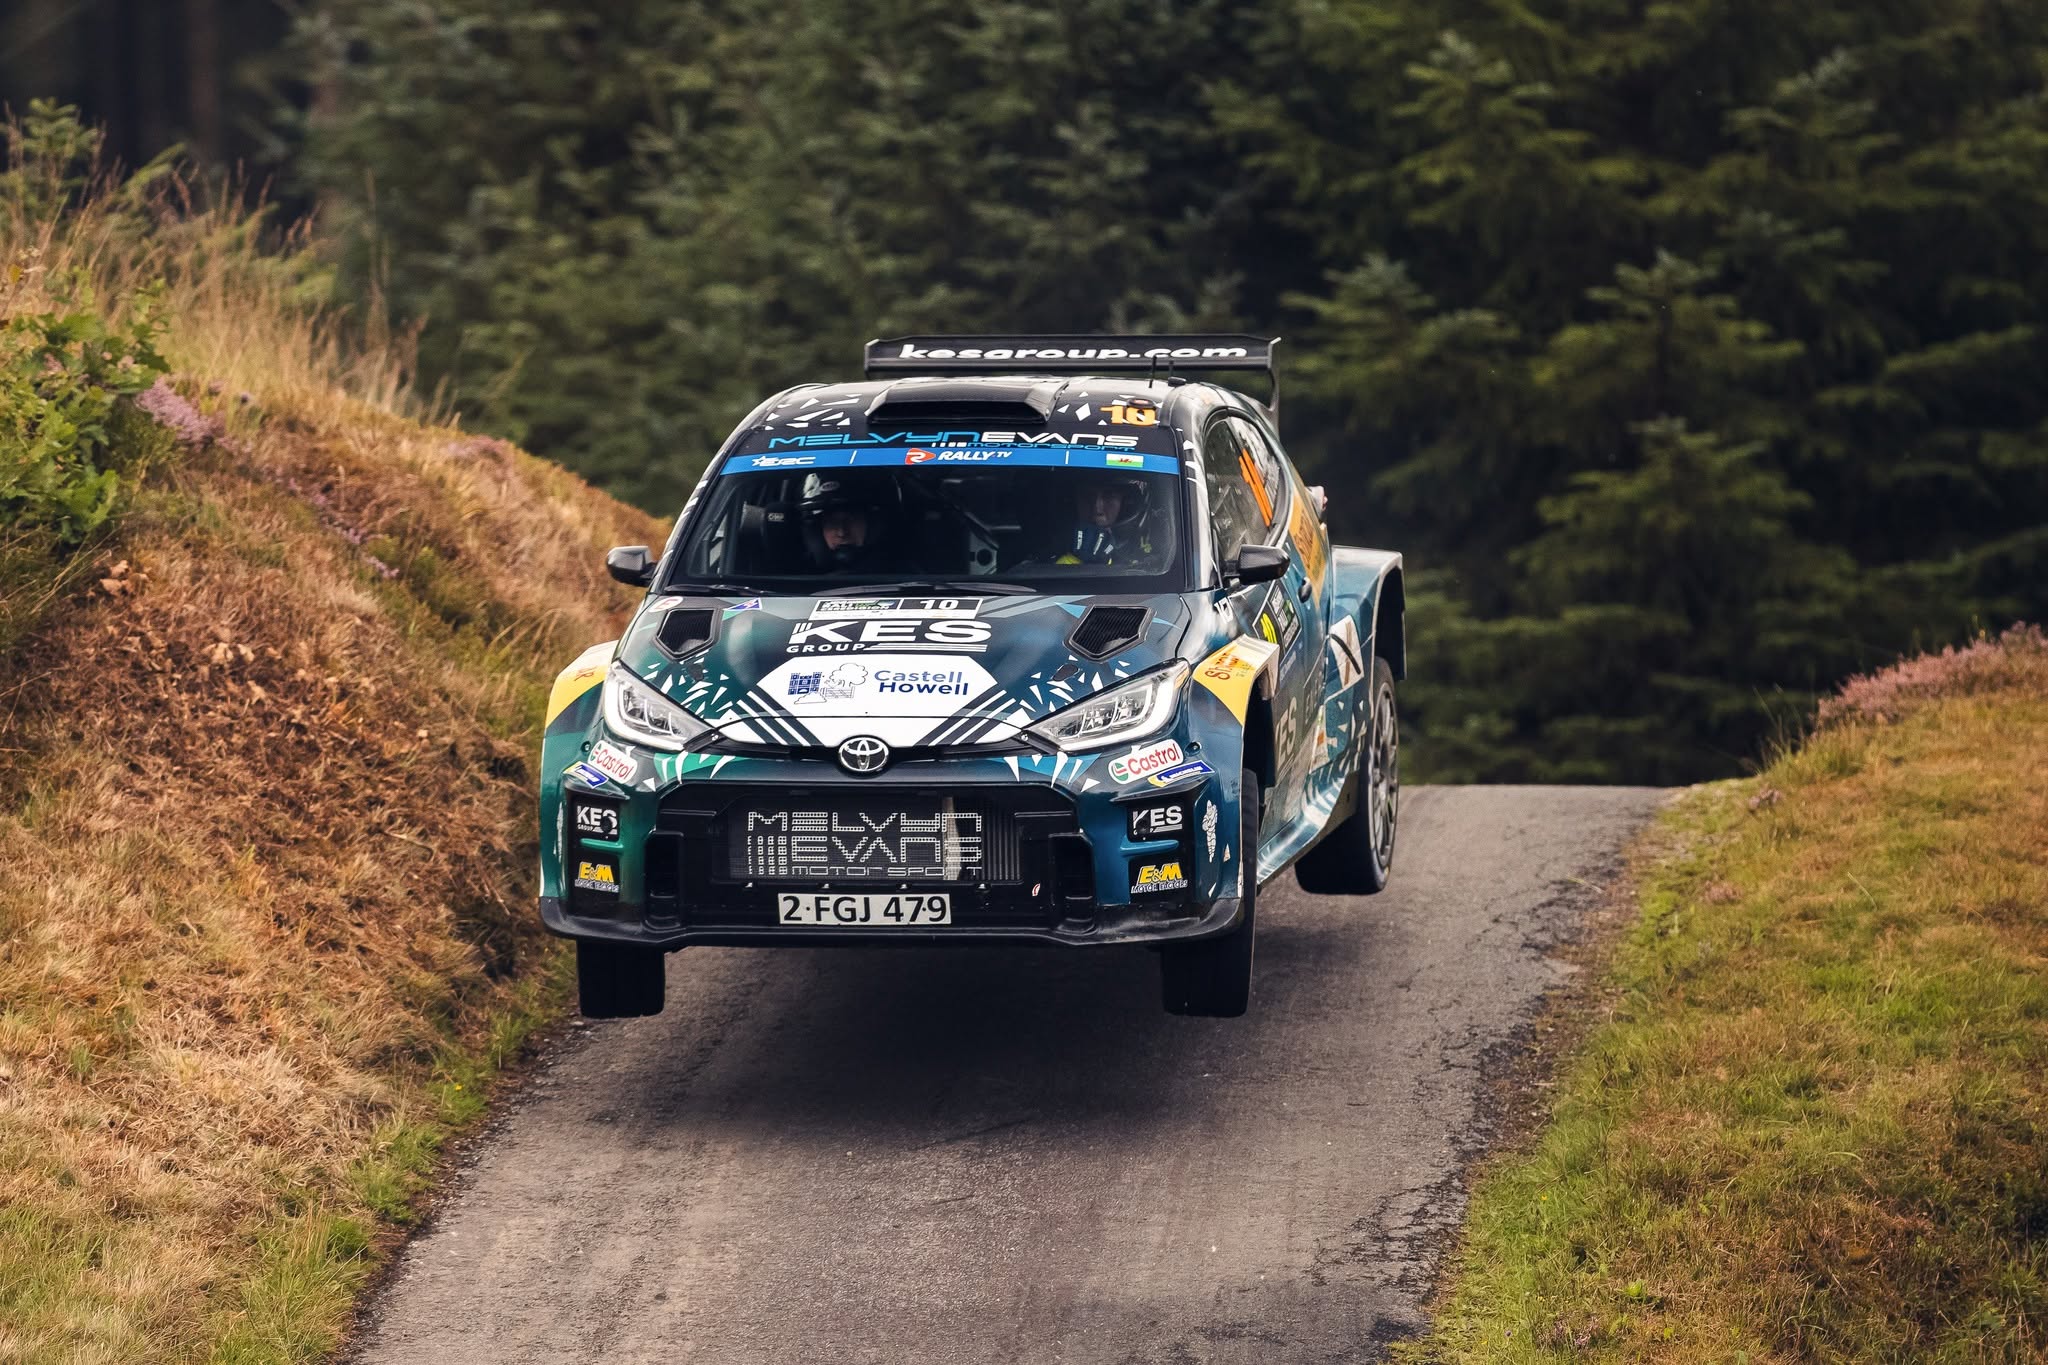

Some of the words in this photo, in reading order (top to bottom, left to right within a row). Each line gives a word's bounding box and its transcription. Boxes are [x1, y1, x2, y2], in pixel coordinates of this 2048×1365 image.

[1101, 405, 1157, 426] 10
[920, 599, 960, 610] 10
[788, 620, 992, 644] KES
[786, 643, 867, 653] GROUP
[874, 670, 963, 683] Castell
[878, 682, 969, 696] Howell
[595, 749, 634, 780] Castrol
[1127, 743, 1181, 776] Castrol
[577, 805, 618, 828] KES
[792, 836, 982, 862] EVANS
[577, 861, 615, 883] E&M
[1137, 862, 1183, 885] E&M
